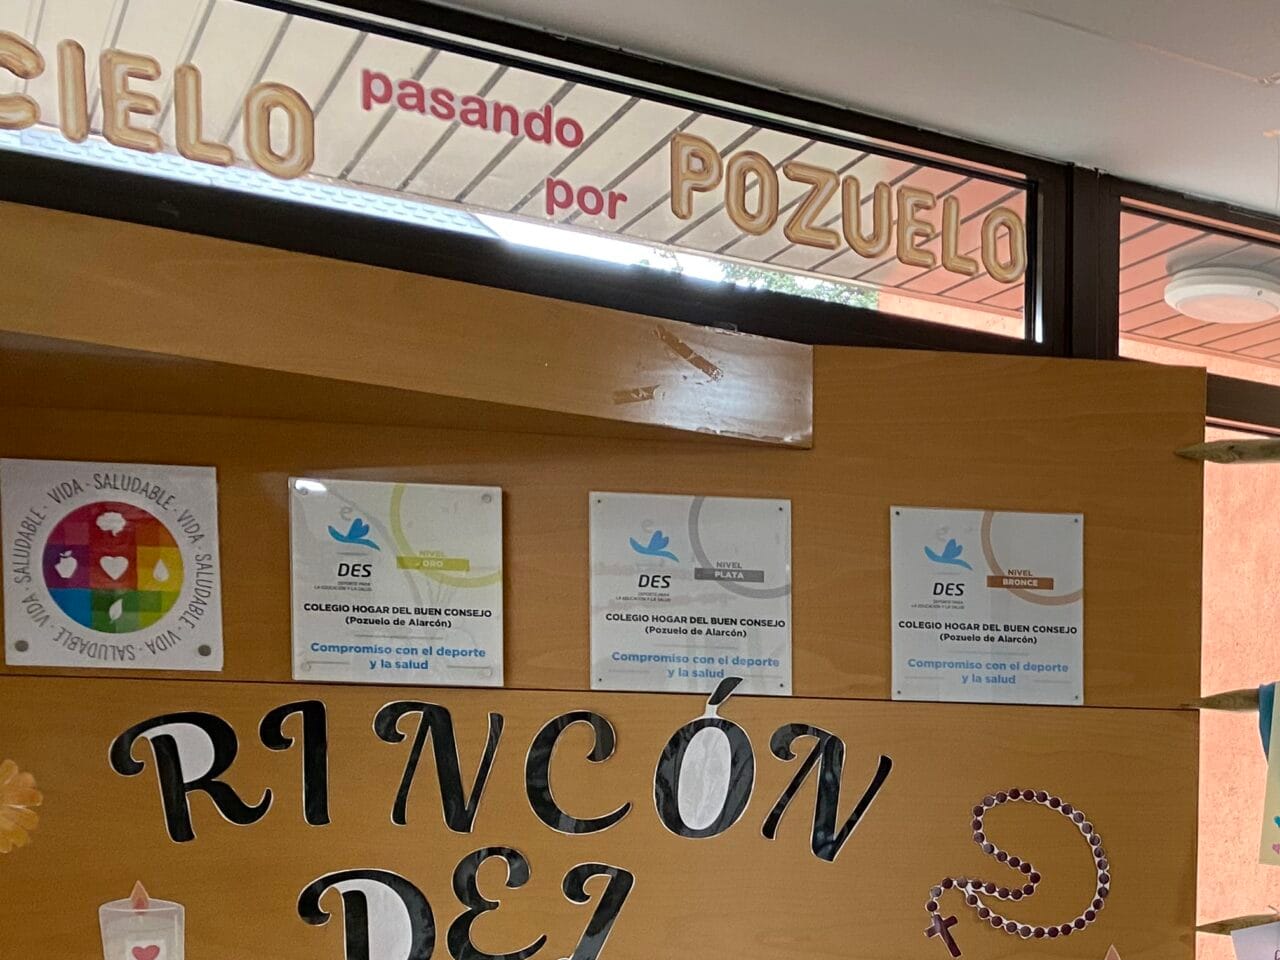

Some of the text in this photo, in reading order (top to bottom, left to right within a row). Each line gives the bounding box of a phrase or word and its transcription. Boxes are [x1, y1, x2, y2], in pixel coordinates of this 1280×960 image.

[0, 30, 315, 179] CIELO
[361, 68, 584, 148] pasando
[546, 178, 627, 220] por
[671, 133, 1027, 283] POZUELO
[12, 473, 214, 661] VIDA SALUDABLE VIDA SALUDABLE VIDA SALUDABLE VIDA SALUDABLE
[337, 563, 372, 578] DES
[423, 560, 444, 568] ORO
[716, 561, 742, 569] NIVEL
[638, 574, 671, 588] DES
[715, 571, 744, 579] PLATA
[933, 582, 964, 596] DES
[1003, 578, 1038, 587] BRONCE
[304, 603, 492, 618] COLEGIO HOGAR DEL BUEN CONSEJO
[345, 616, 451, 628] (Pozuelo de Alarcón)
[606, 613, 785, 627] COLEGIO HOGAR DEL BUEN CONSEJO
[645, 626, 747, 638] (Pozuelo de Alarcón)
[899, 621, 1077, 634] COLEGIO HOGAR DEL BUEN CONSEJO
[940, 633, 1037, 644] (Pozuelo de Alarcón)
[311, 643, 486, 659] Compromiso con el deporte
[369, 659, 429, 670] y la salud
[612, 652, 779, 668] Compromiso con el deporte
[908, 658, 982, 670] Compromiso
[1010, 661, 1020, 671] el
[1023, 662, 1068, 673] deporte
[667, 668, 724, 678] y la salud
[961, 674, 1016, 684] y la salud
[108, 677, 893, 862] RINCÓN
